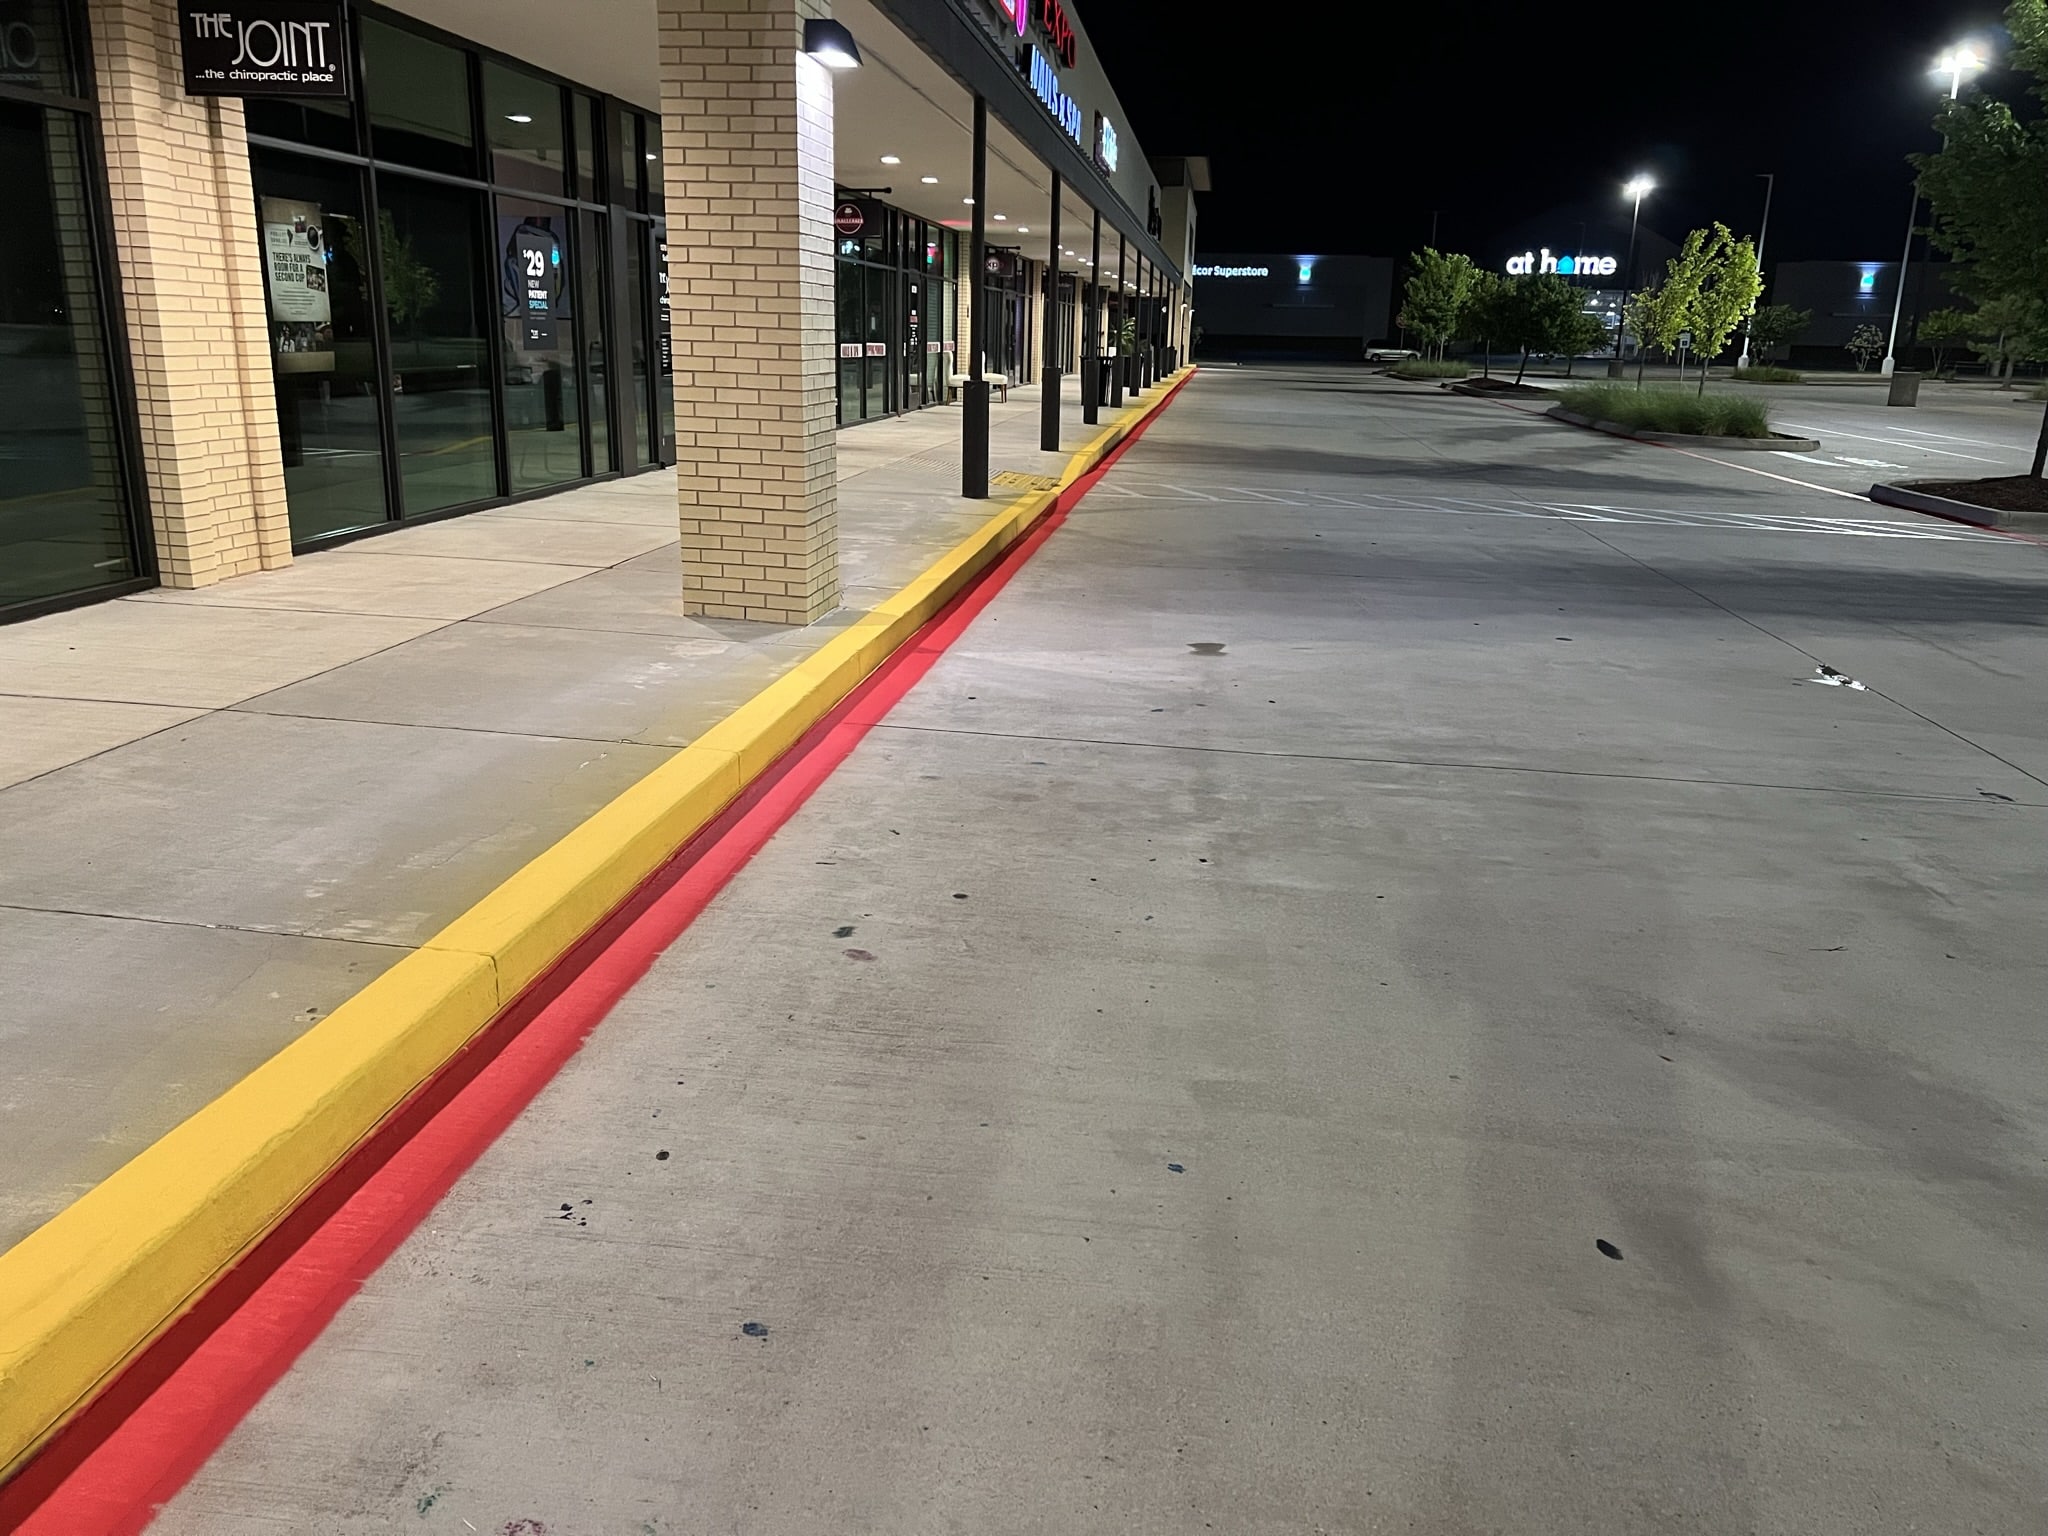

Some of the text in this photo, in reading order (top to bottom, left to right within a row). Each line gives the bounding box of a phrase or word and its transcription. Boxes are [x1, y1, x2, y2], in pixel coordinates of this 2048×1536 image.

[190, 13, 233, 38] THE
[229, 69, 298, 82] chiropractic
[301, 72, 334, 83] place
[1030, 44, 1081, 145] NAILS & SPA
[272, 251, 311, 263] THERE'S ALWAYS
[522, 249, 545, 277] $29
[1506, 251, 1535, 275] at
[274, 262, 288, 271] ROOM
[289, 263, 299, 272] FOR
[1213, 265, 1269, 278] Superstore
[275, 272, 305, 282] SECOND CUP
[528, 280, 540, 288] NEW
[528, 289, 548, 299] PATIENT
[528, 300, 549, 309] SPECIAL
